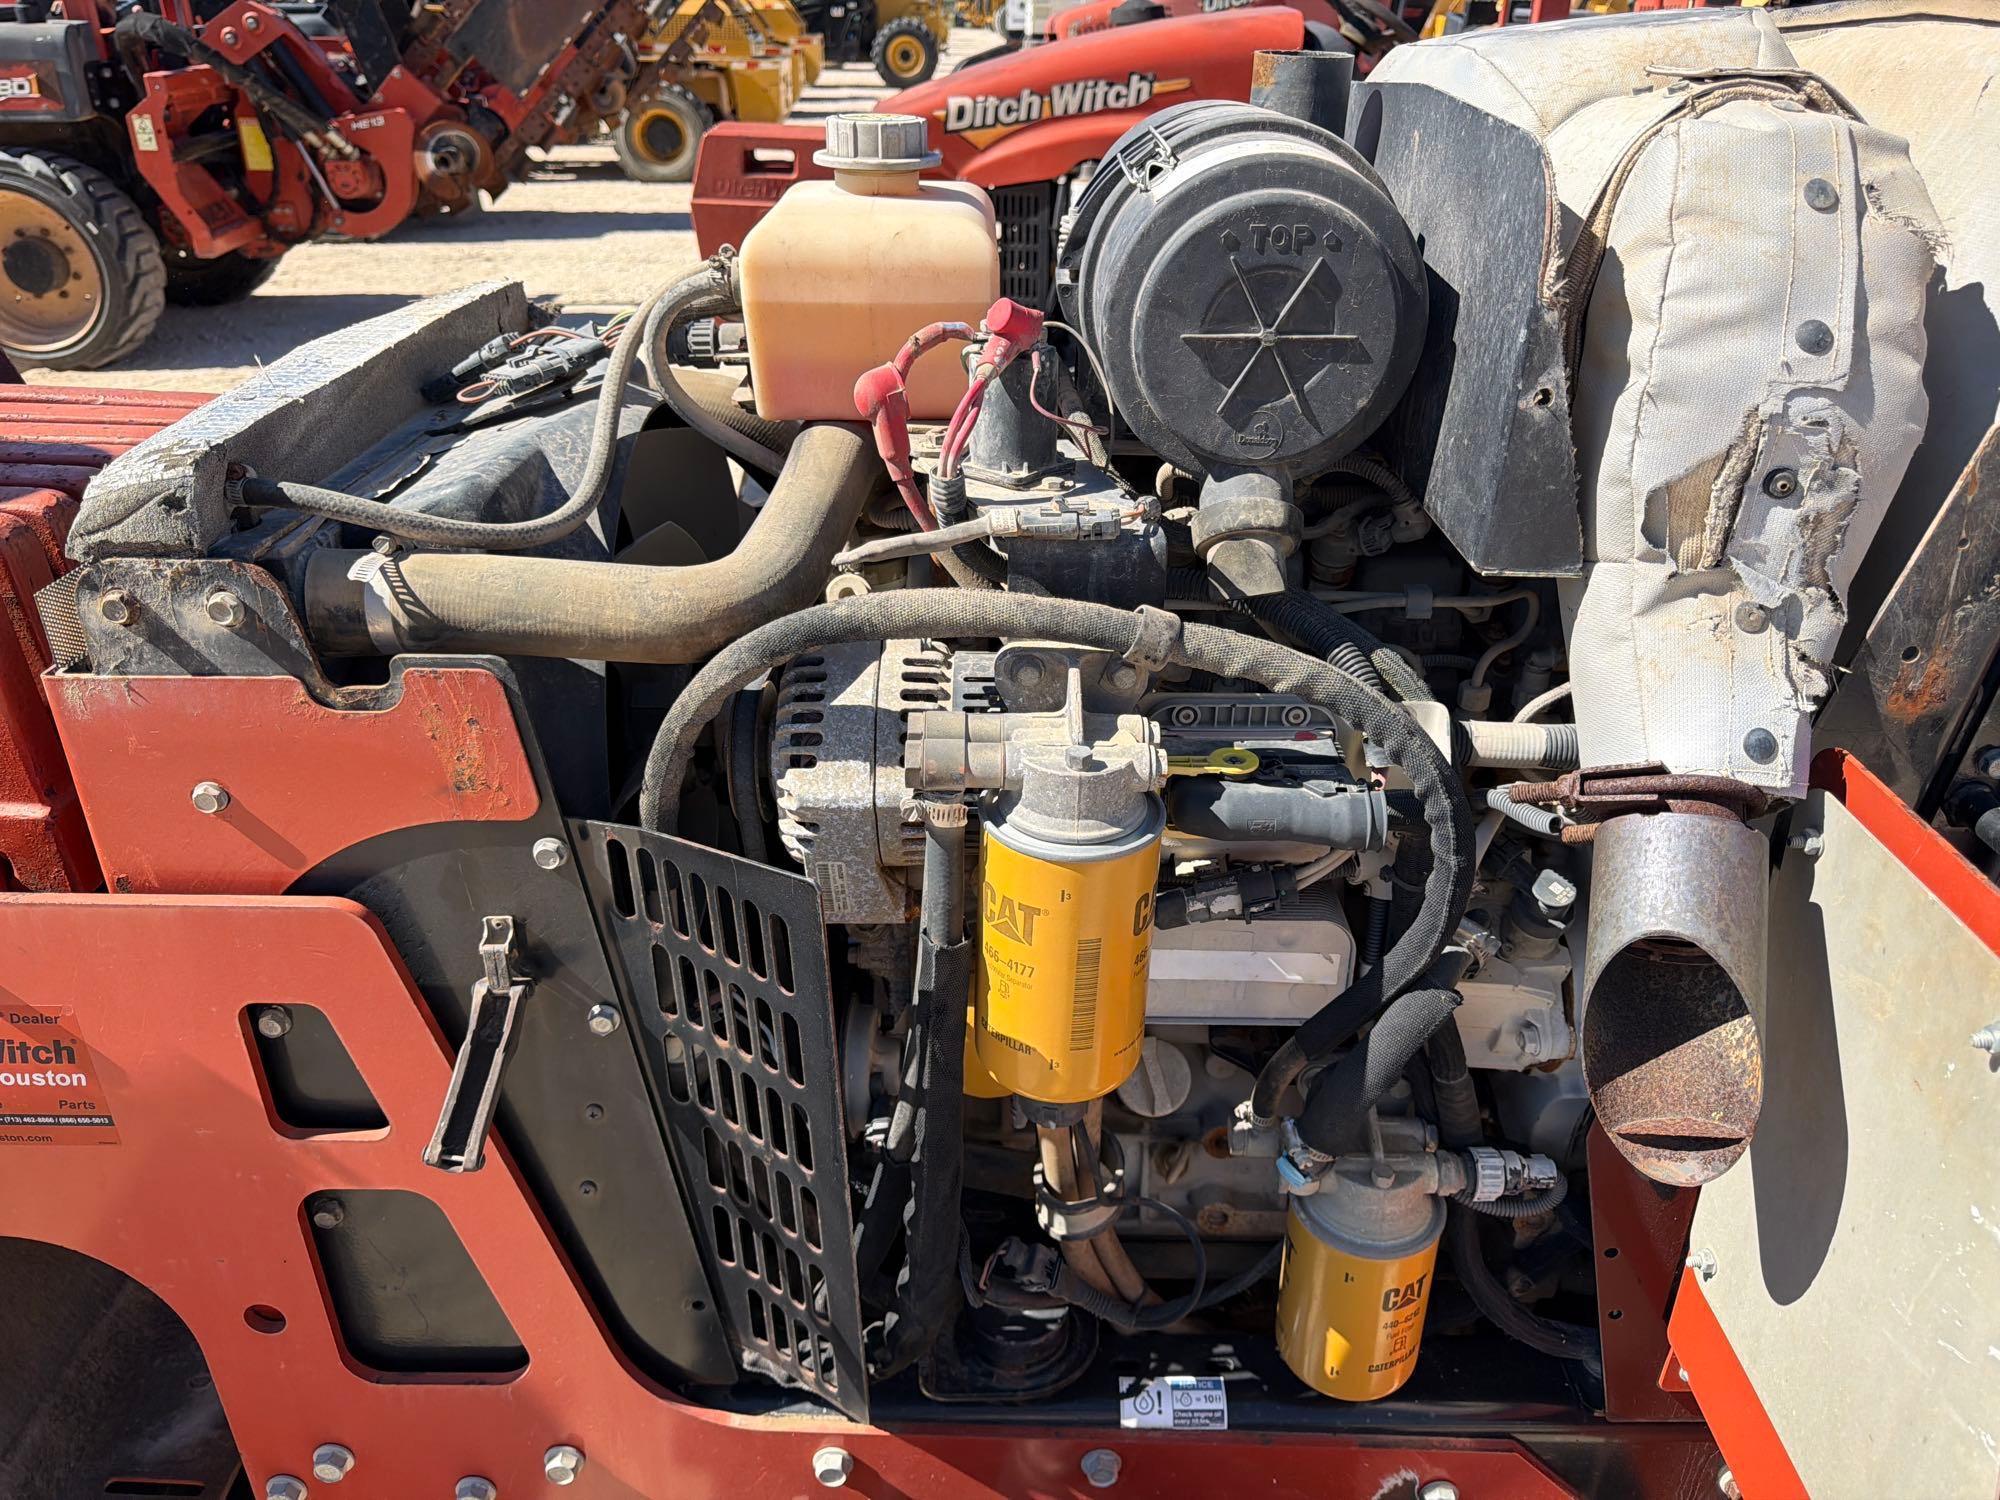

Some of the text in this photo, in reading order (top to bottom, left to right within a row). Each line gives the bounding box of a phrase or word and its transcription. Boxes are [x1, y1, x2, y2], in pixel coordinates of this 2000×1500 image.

[946, 73, 1152, 132] Ditch Witch
[1248, 223, 1316, 256] TOP
[9, 1013, 60, 1025] Dealer
[0, 1070, 87, 1087] ouston
[59, 1100, 96, 1110] Parts
